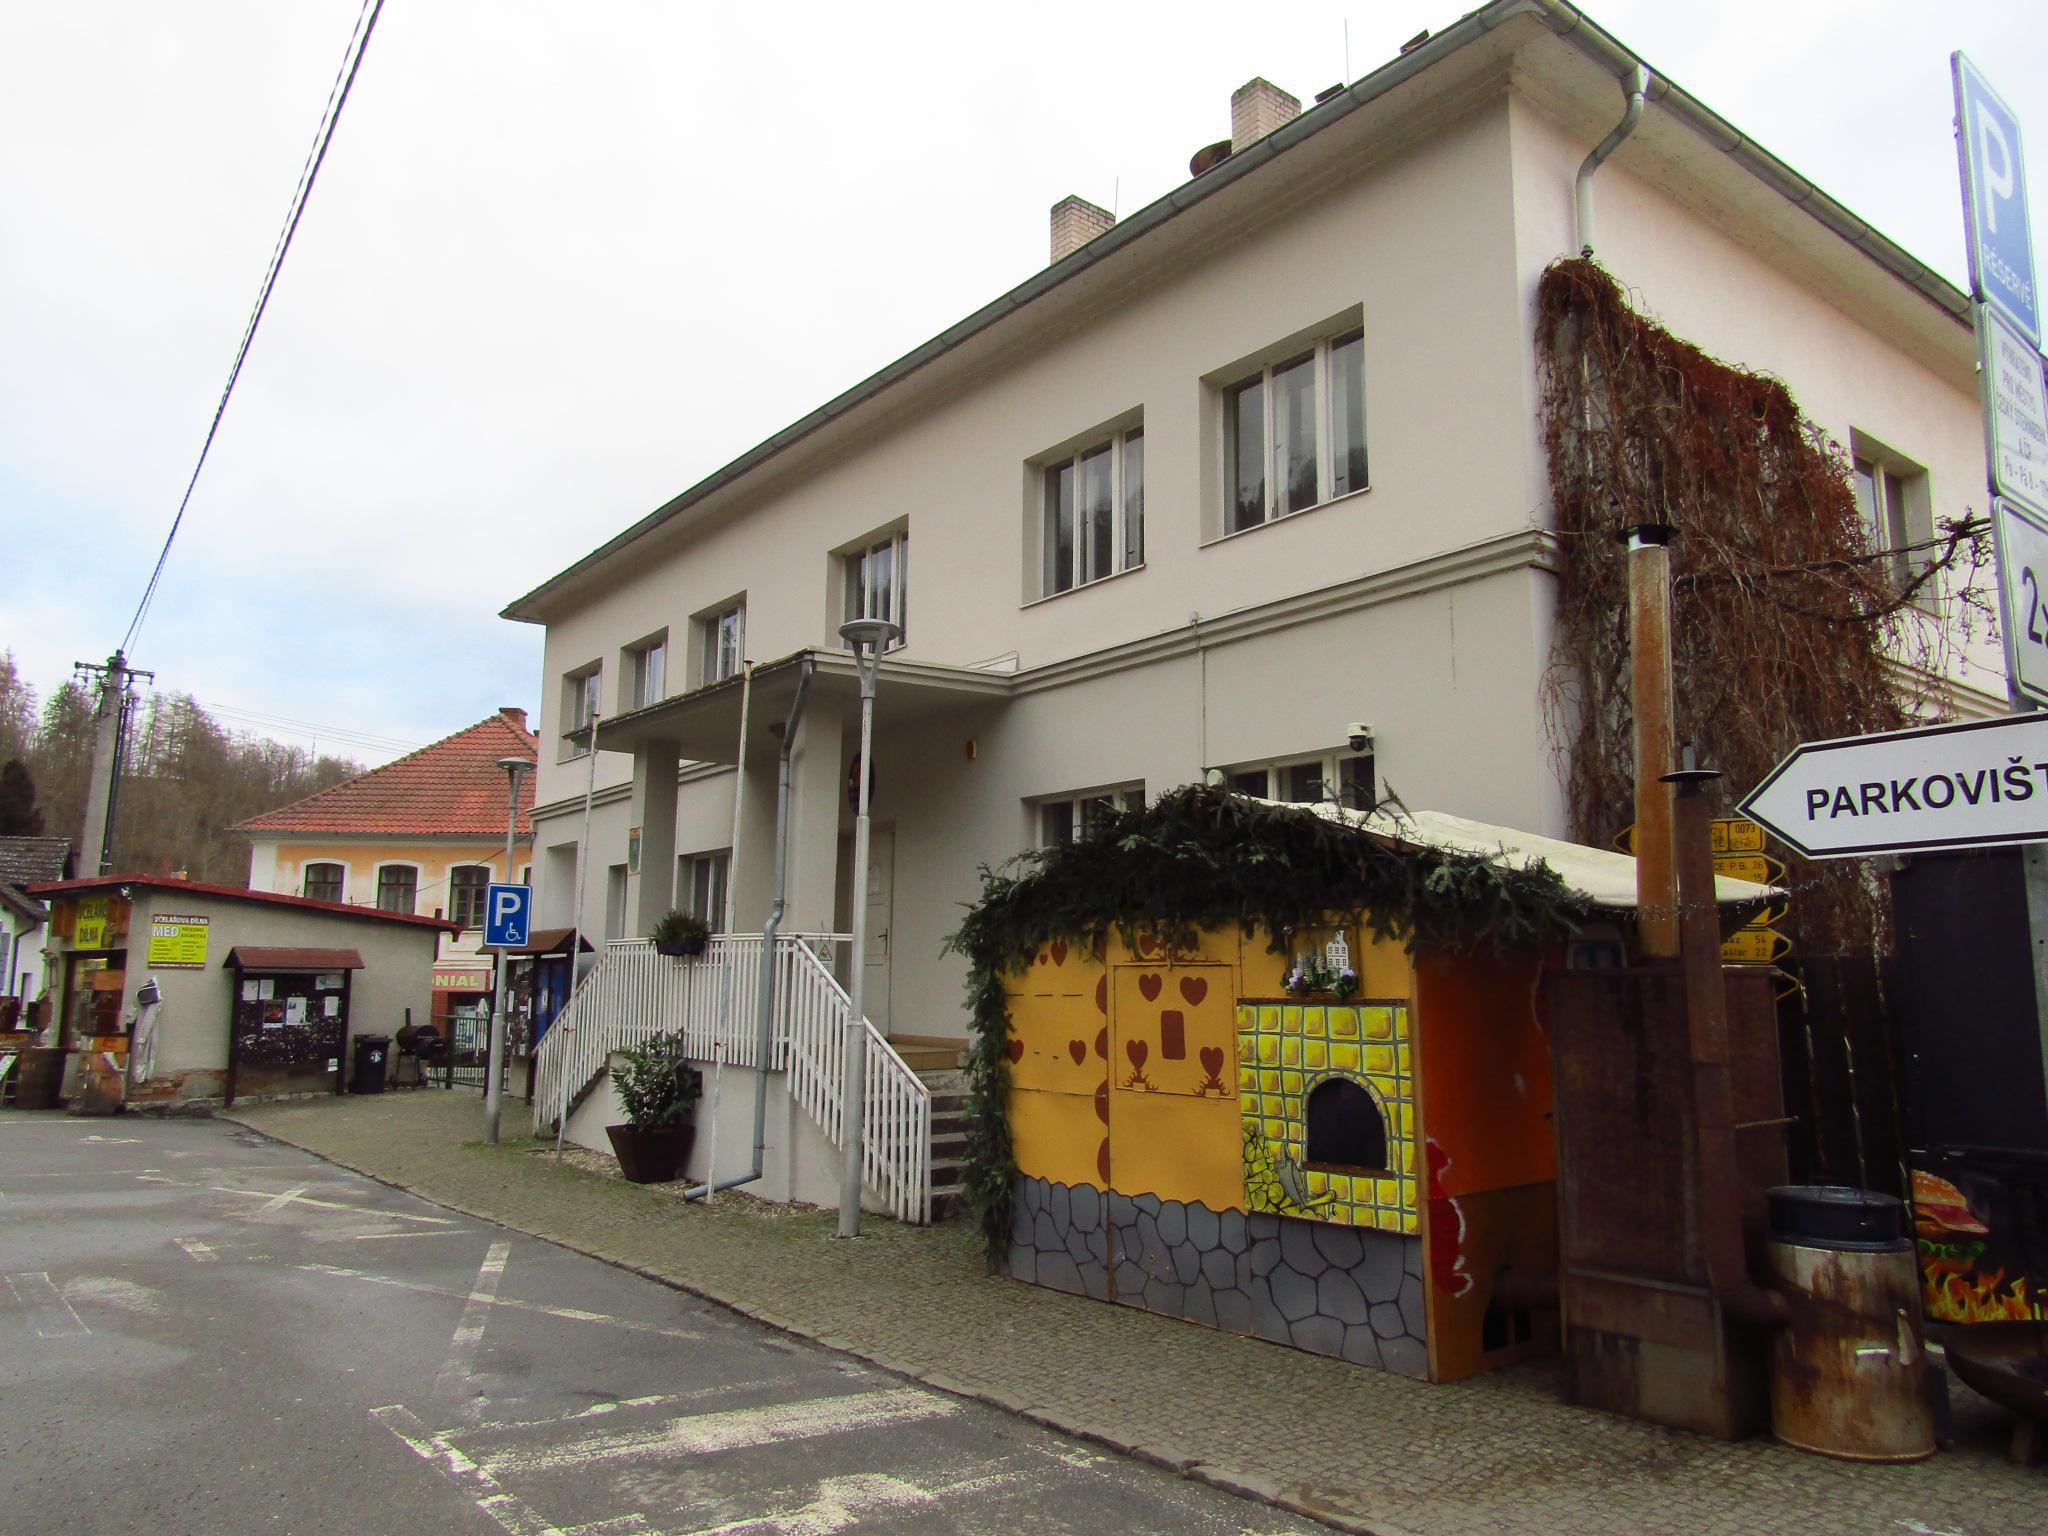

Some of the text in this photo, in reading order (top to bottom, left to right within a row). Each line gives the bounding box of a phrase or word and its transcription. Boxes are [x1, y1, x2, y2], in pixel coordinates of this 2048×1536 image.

[1975, 99, 2013, 235] P
[190, 917, 208, 925] DÍLNA
[495, 891, 521, 927] P
[152, 925, 180, 938] MED
